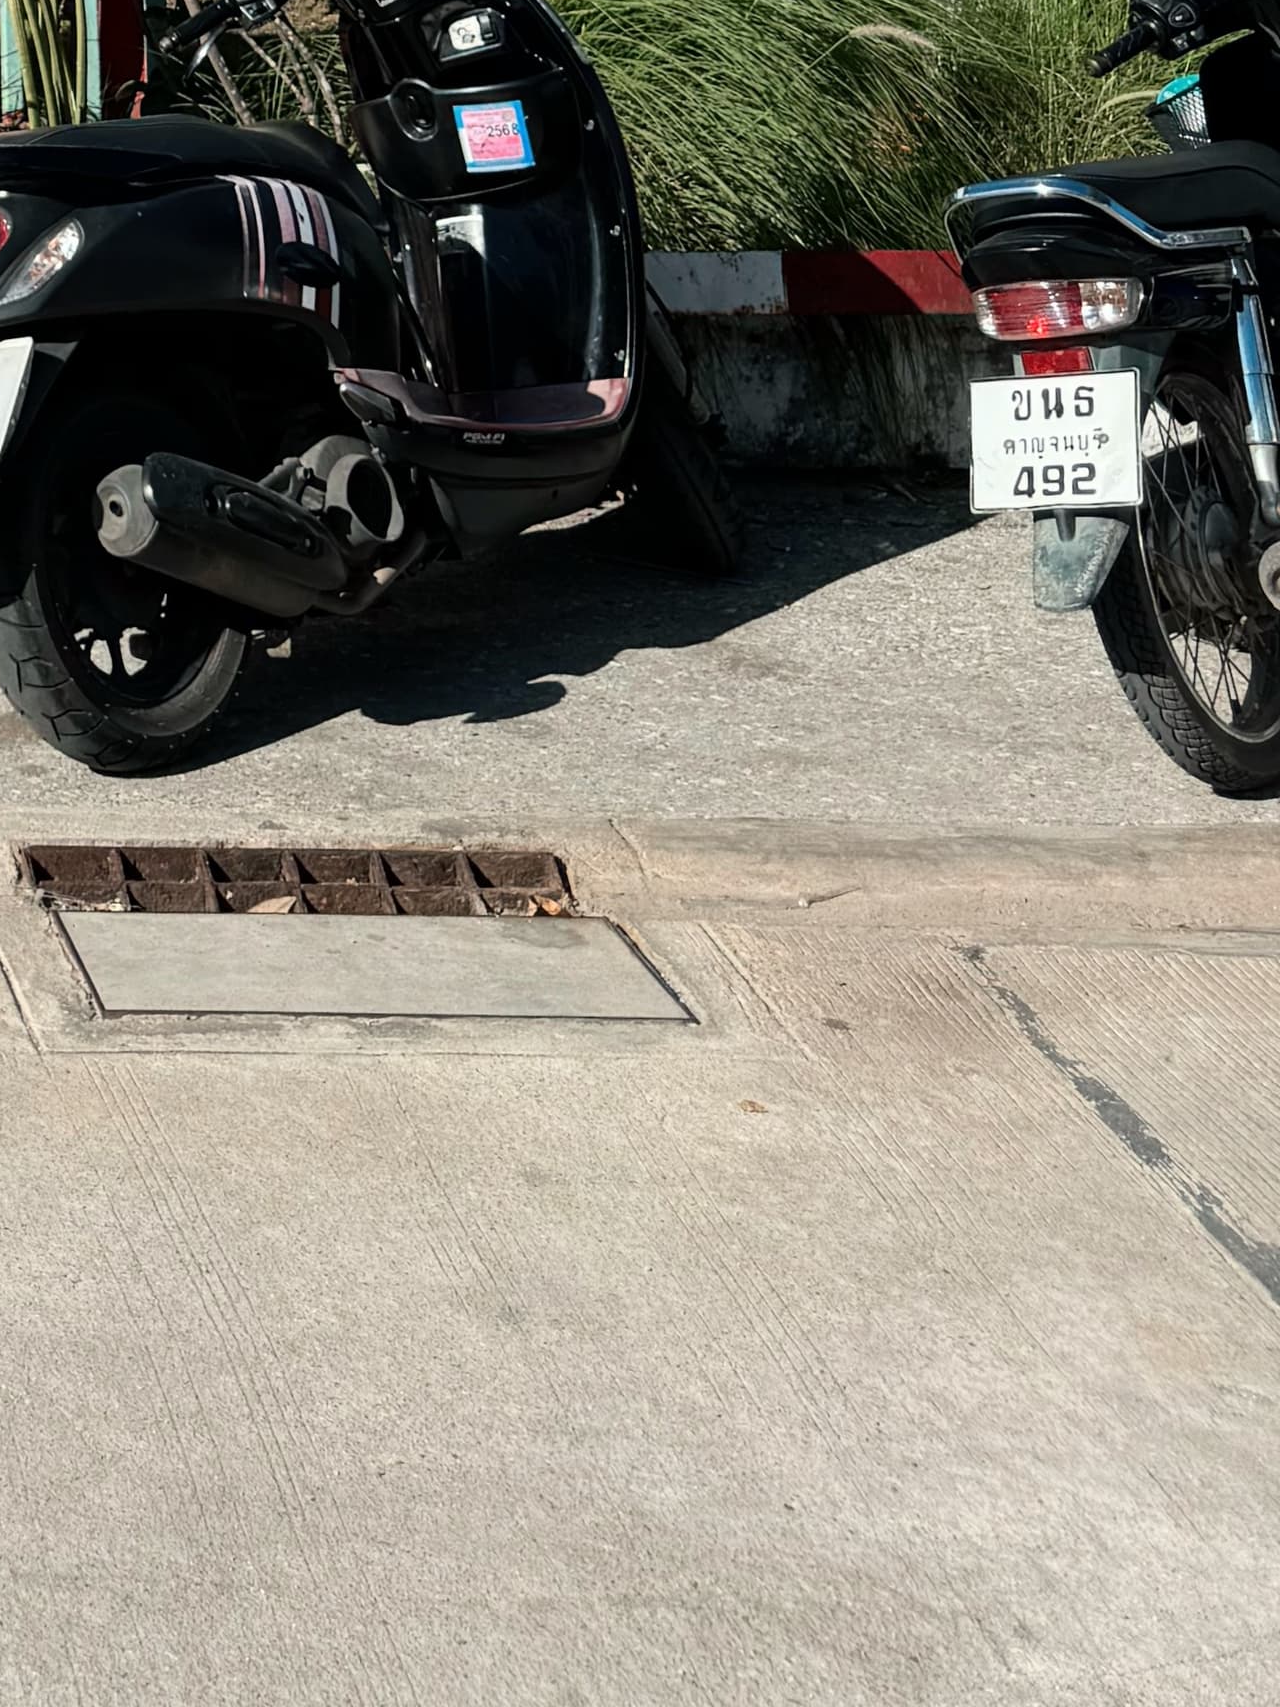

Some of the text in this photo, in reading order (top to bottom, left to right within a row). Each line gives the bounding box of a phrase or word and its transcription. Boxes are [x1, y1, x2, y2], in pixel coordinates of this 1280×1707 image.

[486, 122, 520, 138] 2568
[1012, 385, 1095, 421] ขนธ
[1013, 463, 1096, 498] 492
